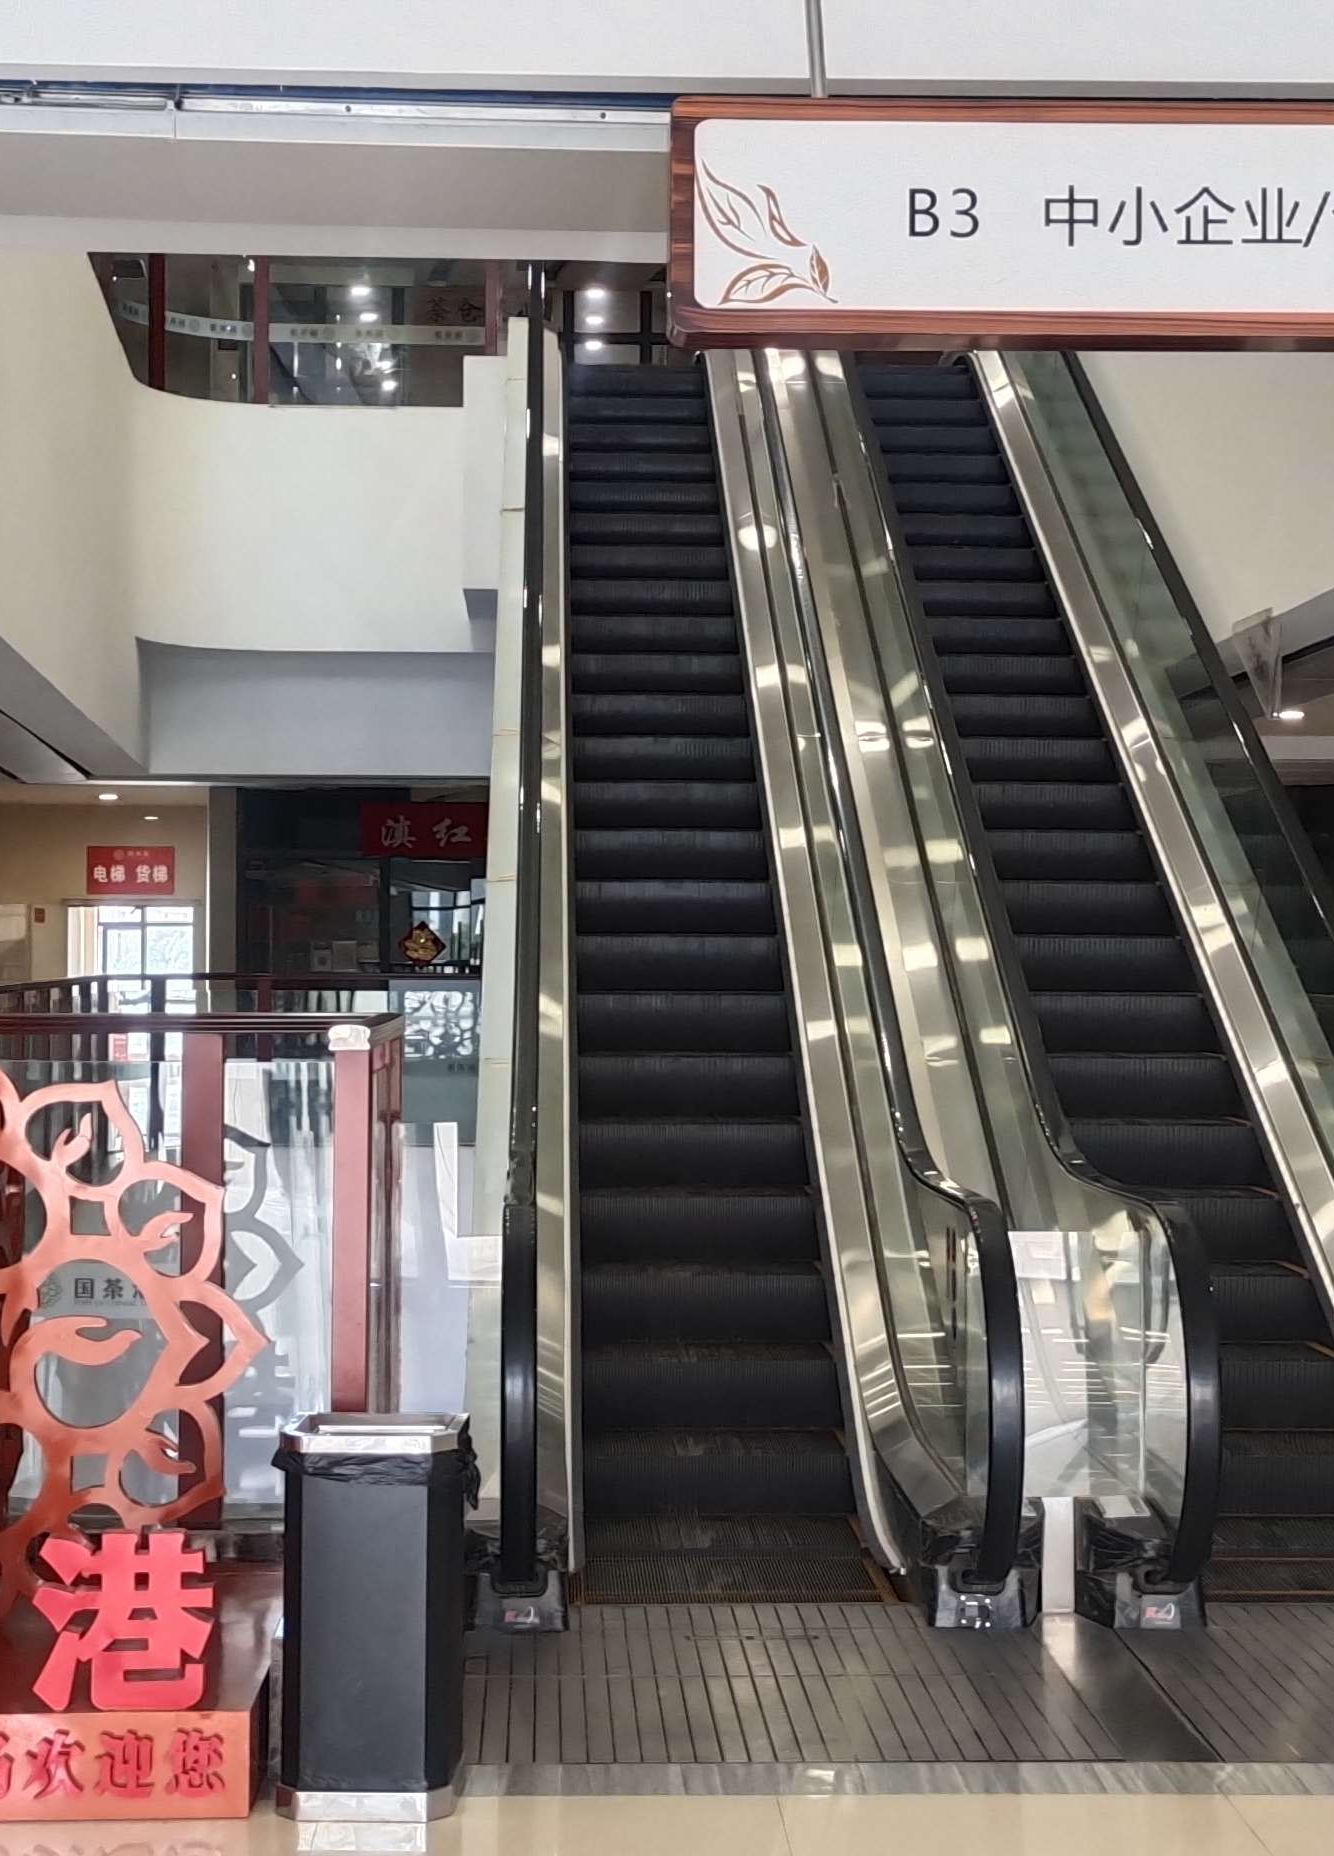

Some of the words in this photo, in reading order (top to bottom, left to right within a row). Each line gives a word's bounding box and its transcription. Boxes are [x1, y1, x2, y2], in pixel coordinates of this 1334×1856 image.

[909, 188, 979, 238] B3
[380, 815, 472, 849] 滇红
[93, 865, 126, 883] 电梯
[136, 865, 168, 883] 货梯
[74, 1277, 142, 1300] 国茶
